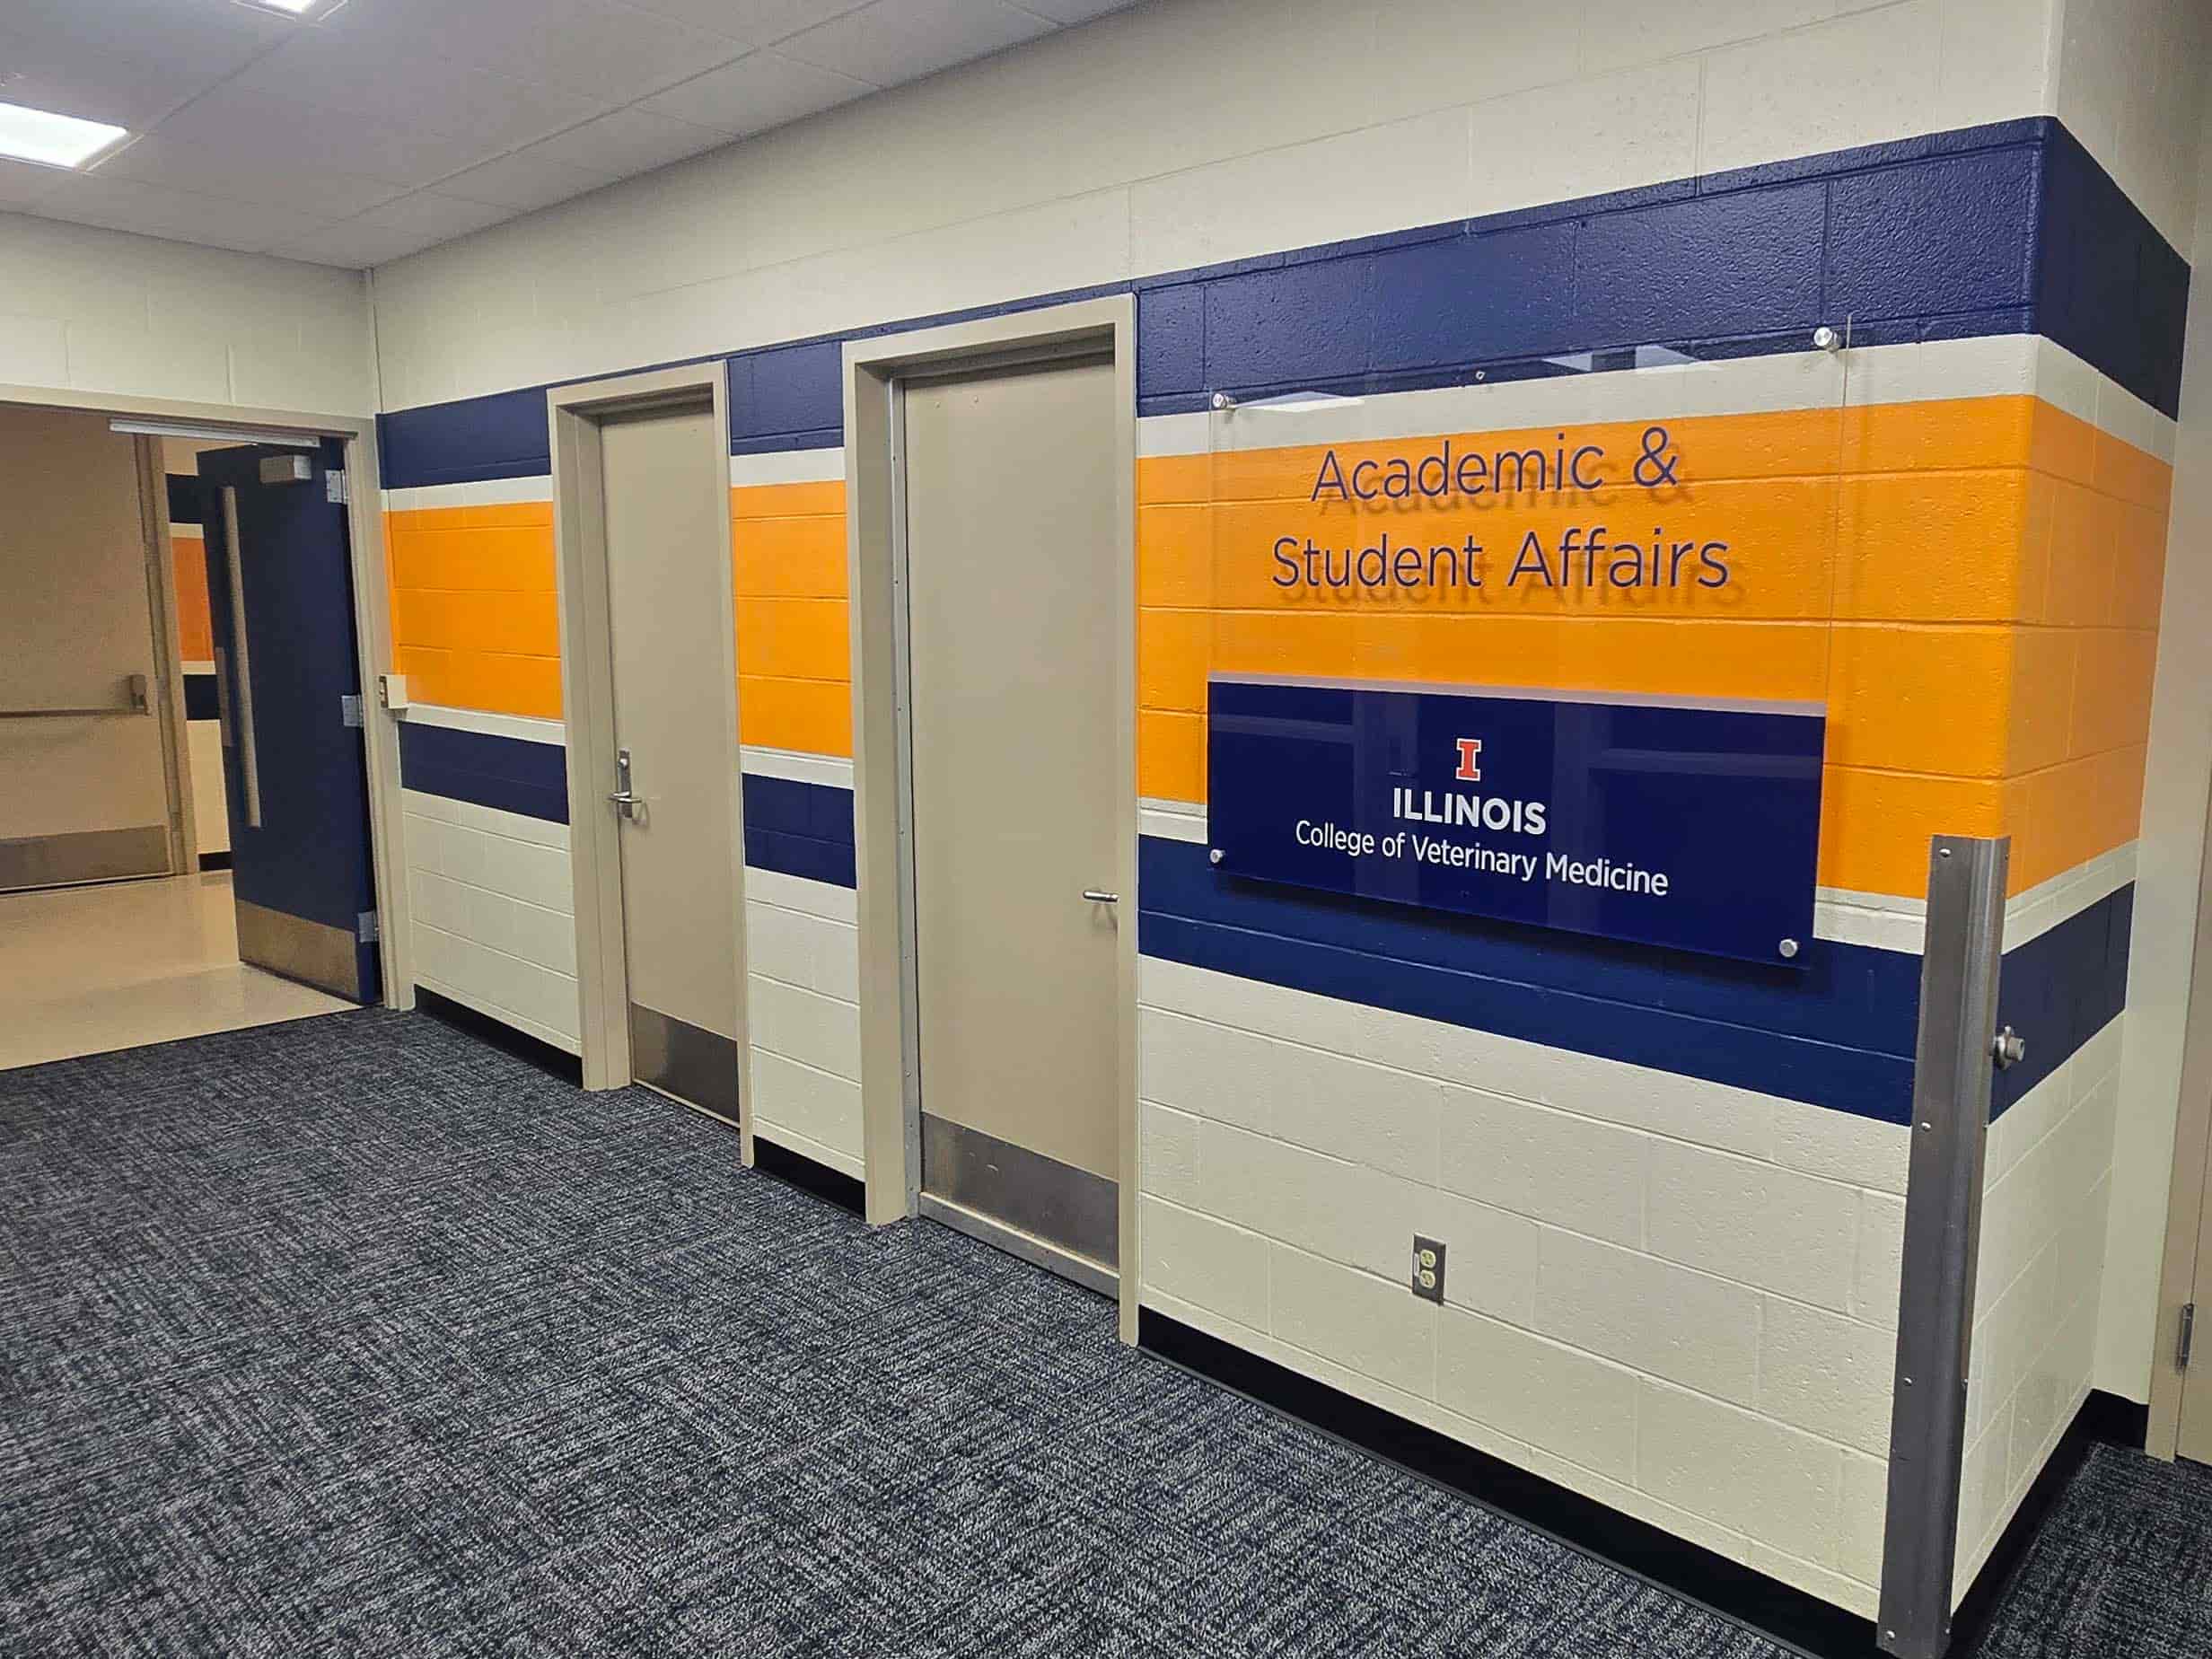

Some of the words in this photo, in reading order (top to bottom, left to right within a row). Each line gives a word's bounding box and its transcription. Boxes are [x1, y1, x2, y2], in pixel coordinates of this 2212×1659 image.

[1311, 432, 1604, 502] Academic
[1633, 426, 1679, 487] &
[1272, 533, 1481, 589] Student
[1508, 527, 1730, 589] Affairs
[1455, 738, 1482, 781] I
[1392, 787, 1547, 835] ILLINOIS
[1295, 820, 1374, 857] College
[1381, 832, 1406, 859] of
[1411, 836, 1537, 882] Veterinary
[1545, 852, 1669, 896] Medicine
